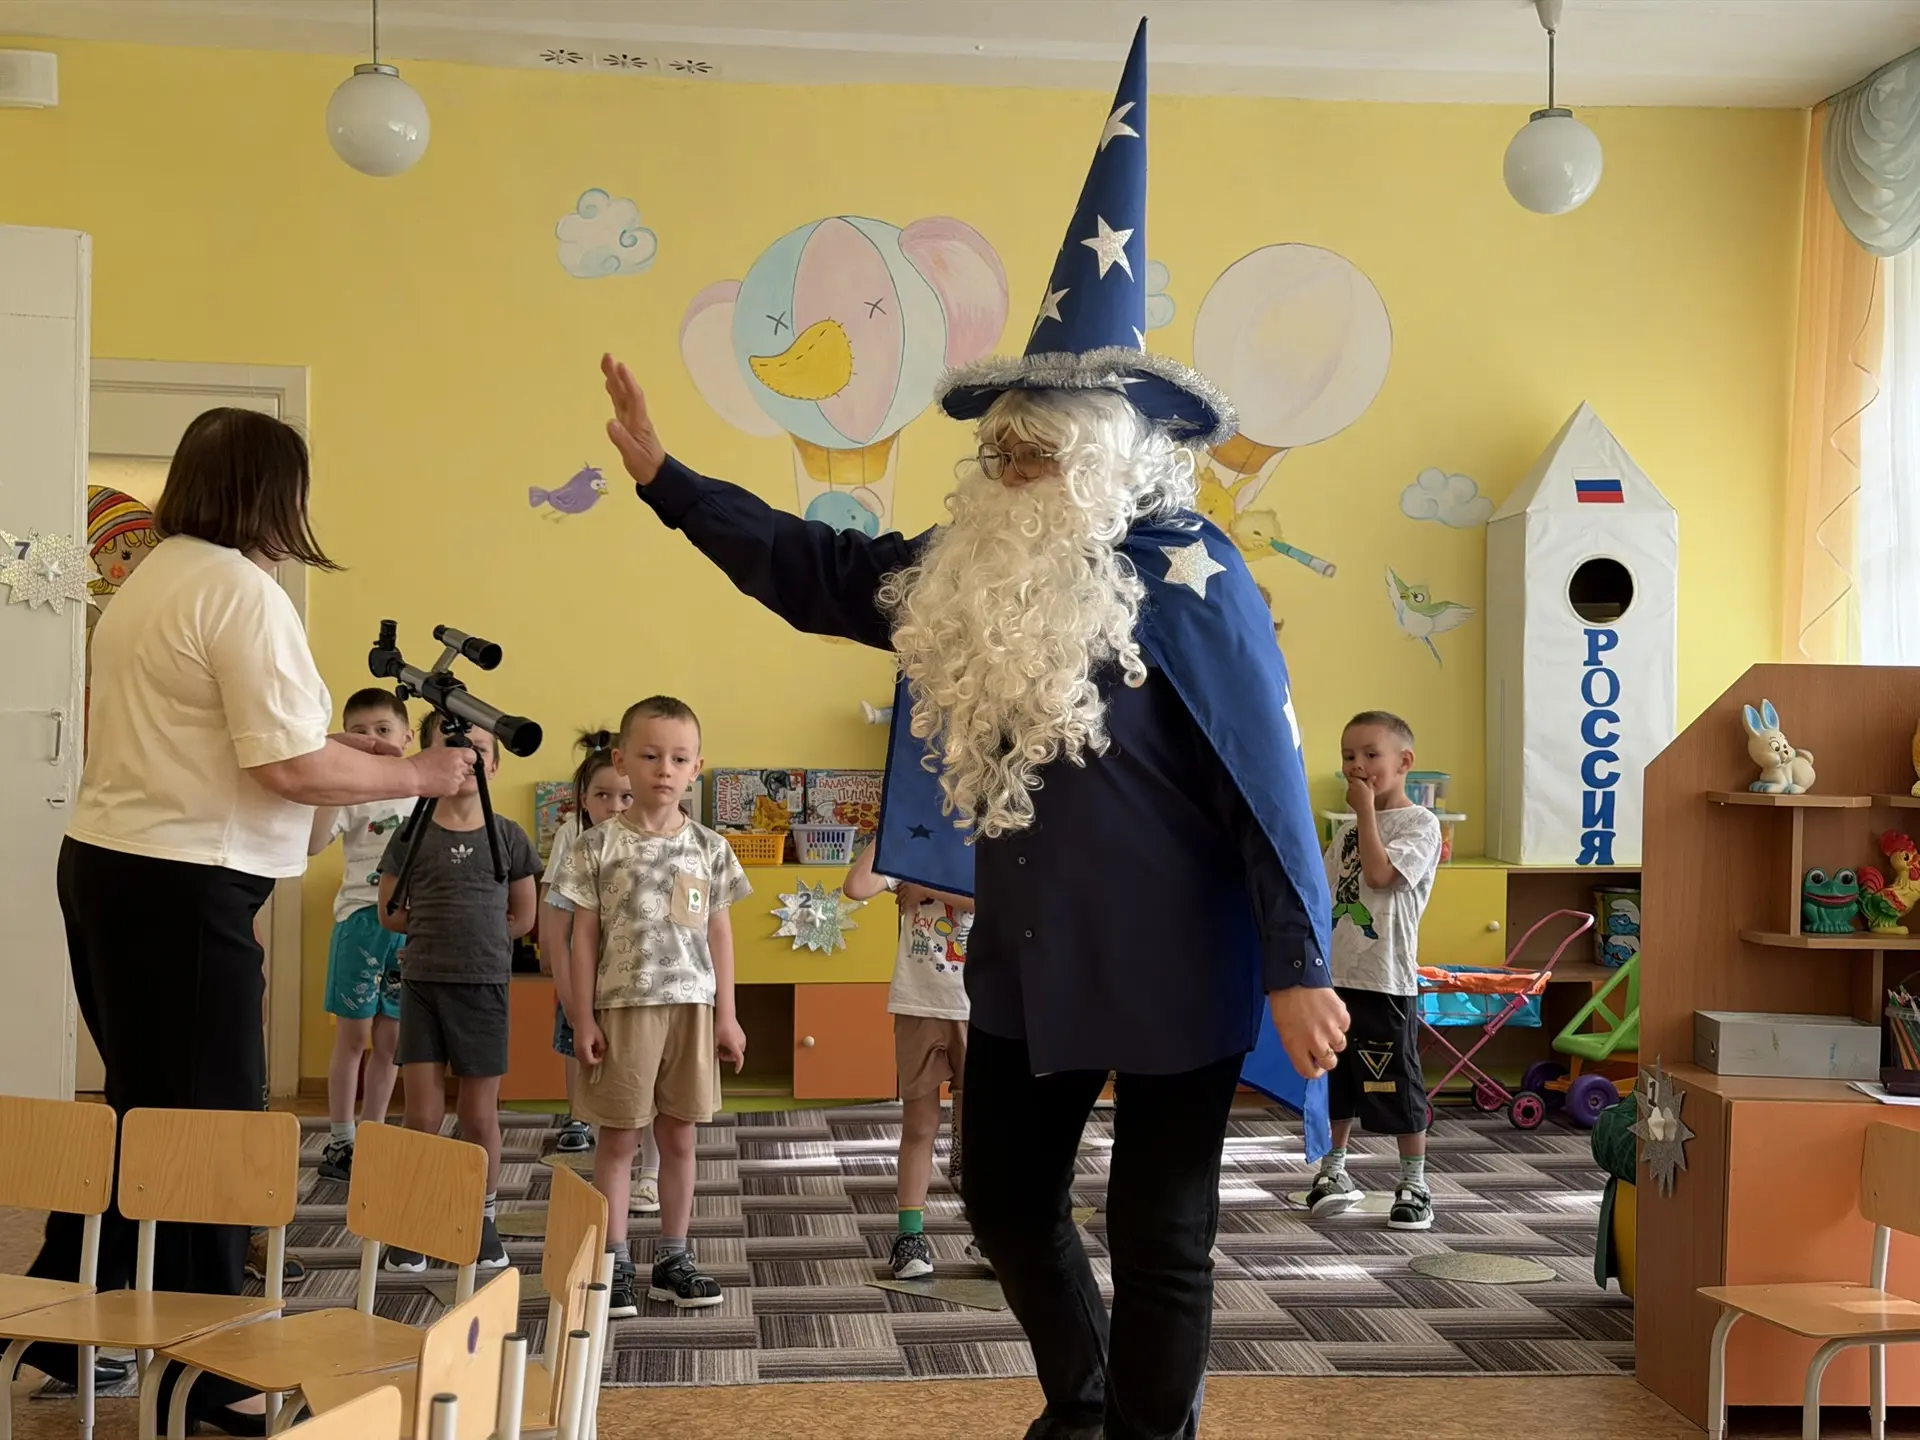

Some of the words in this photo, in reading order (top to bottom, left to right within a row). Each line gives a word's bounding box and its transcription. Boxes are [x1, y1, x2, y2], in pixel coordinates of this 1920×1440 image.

[14, 541, 31, 560] 7
[1575, 628, 1621, 866] РОССИЯ
[730, 783, 741, 819] ОХОТА
[837, 787, 875, 802] ПИЦЦА
[798, 893, 811, 908] 2
[1648, 1081, 1657, 1107] 1
